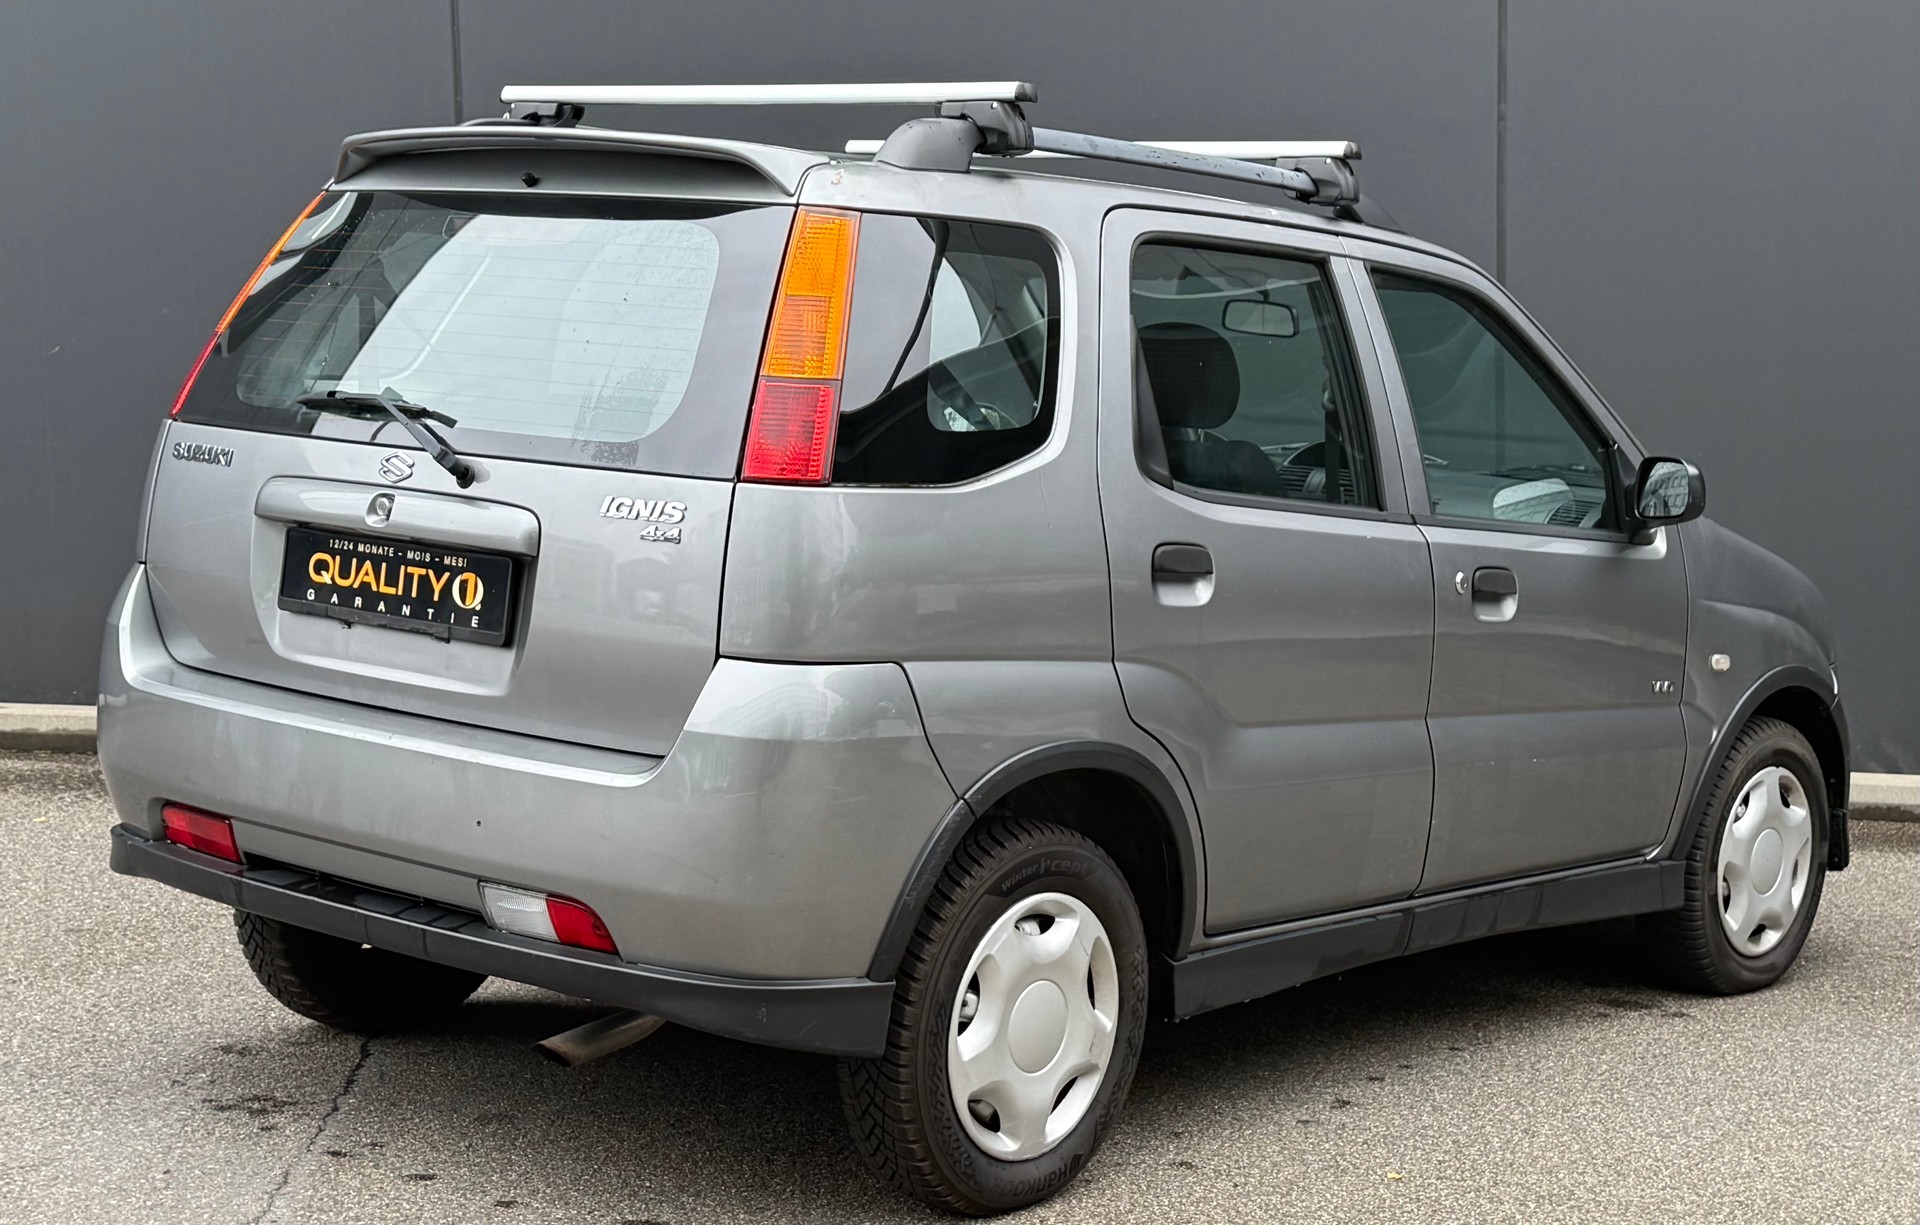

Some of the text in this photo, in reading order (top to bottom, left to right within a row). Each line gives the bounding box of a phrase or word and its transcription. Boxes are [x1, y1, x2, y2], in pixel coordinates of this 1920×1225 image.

[172, 442, 234, 467] SUZUKI
[600, 495, 687, 524] IGNIS
[640, 524, 681, 544] 4x4
[329, 539, 354, 551] 12/24
[357, 541, 395, 557] MONATE
[406, 550, 431, 563] MOIS
[444, 555, 468, 568] MESI
[308, 552, 451, 602] QUALITY
[306, 588, 480, 628] GARANTIE
